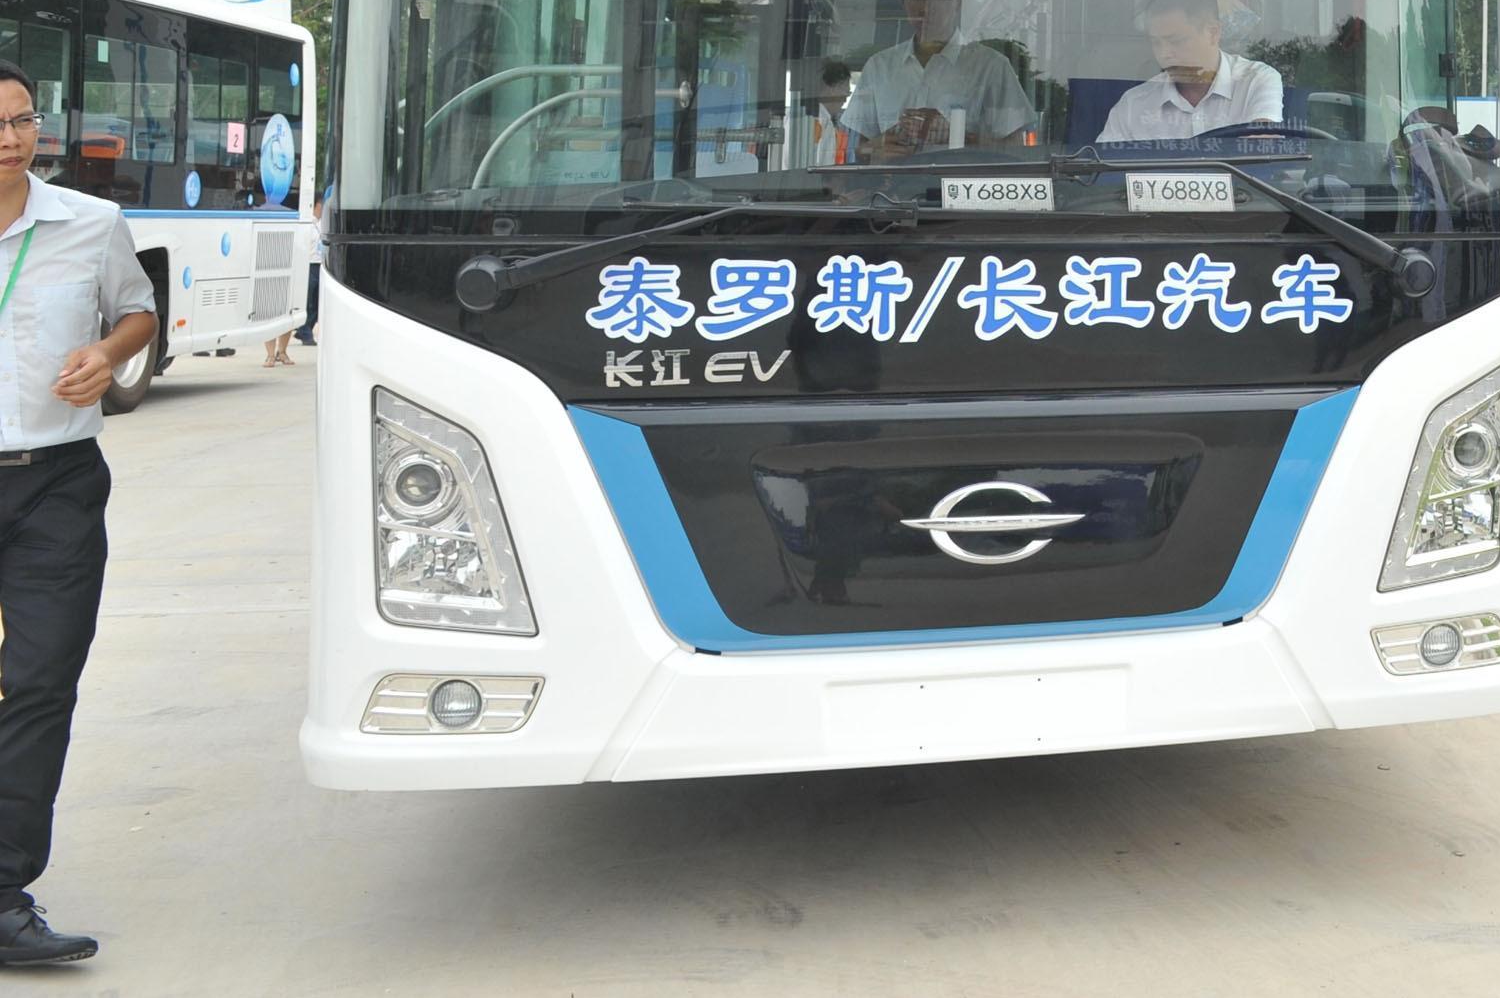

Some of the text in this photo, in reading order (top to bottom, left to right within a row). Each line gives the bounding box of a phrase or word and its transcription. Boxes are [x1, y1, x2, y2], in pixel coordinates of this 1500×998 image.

[586, 252, 1355, 344] 泰罗斯/长江汽车
[603, 349, 792, 388] 长江 EV
